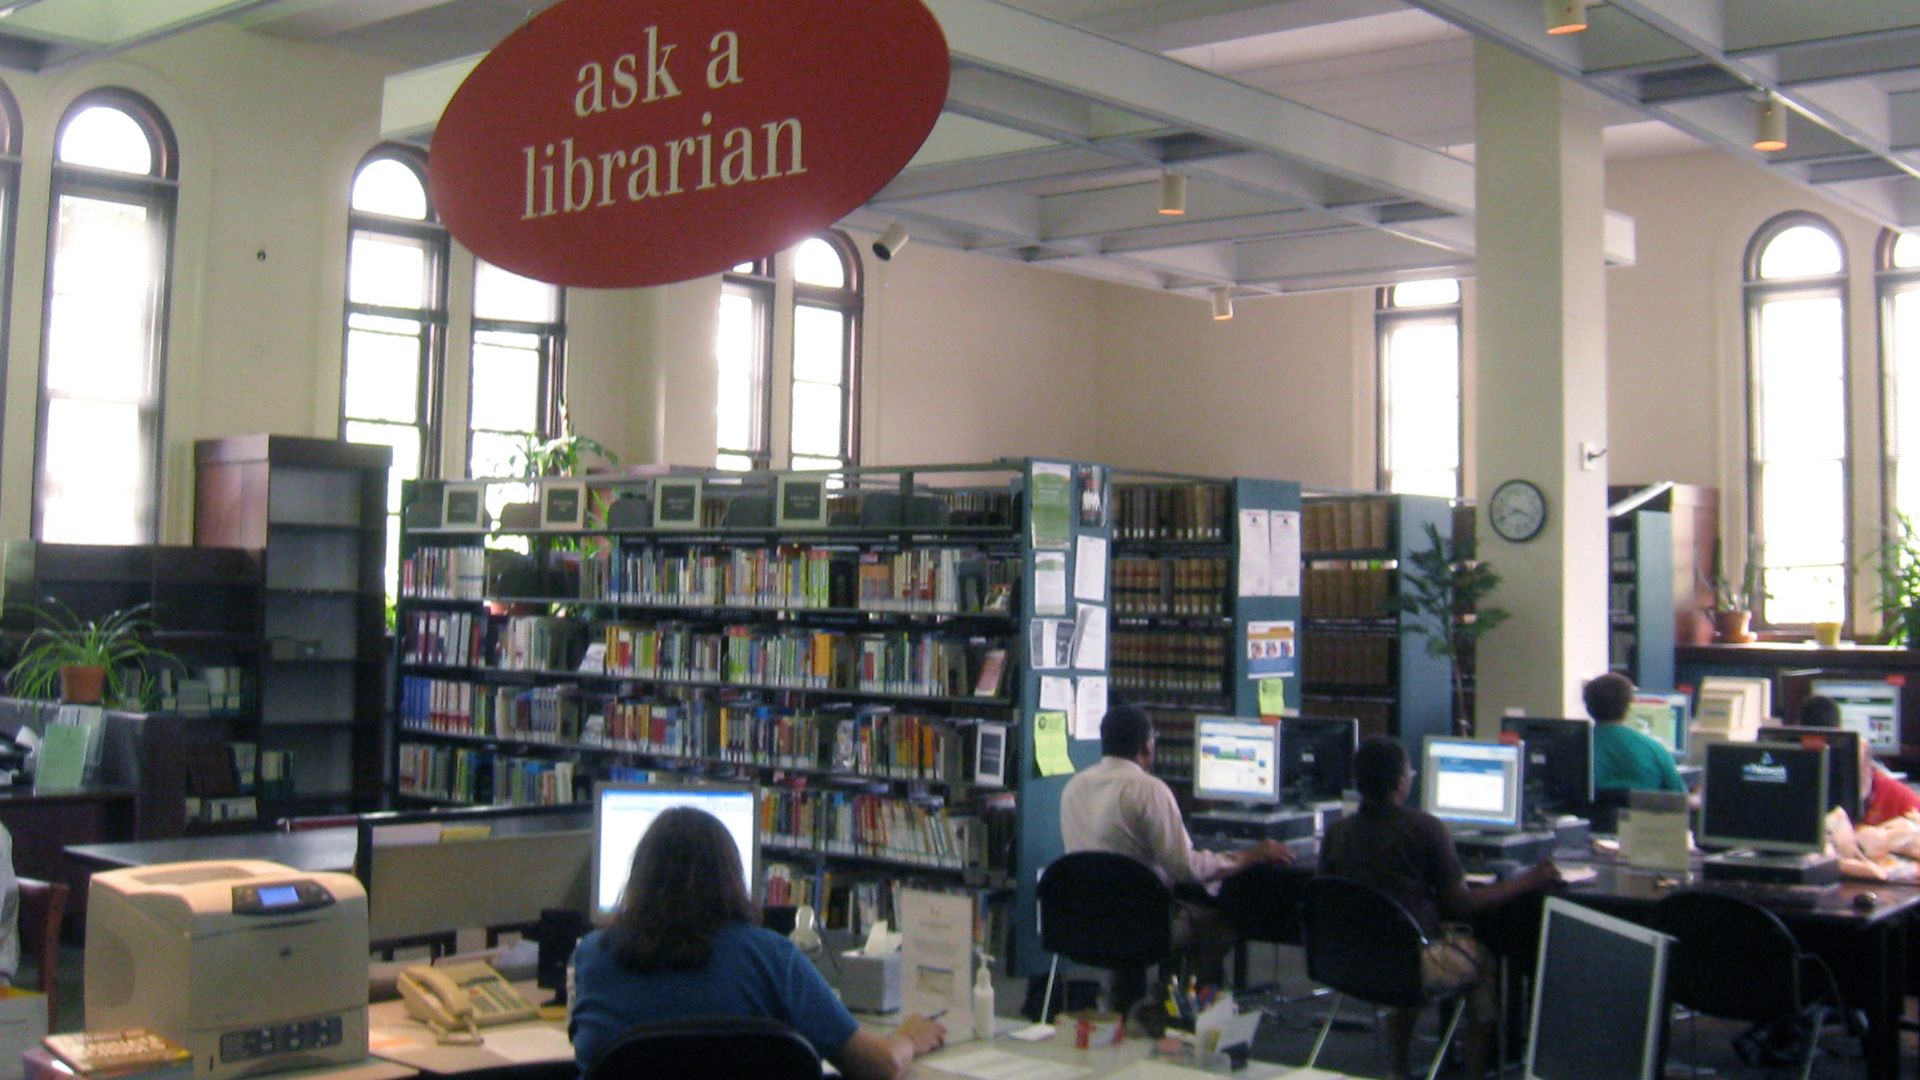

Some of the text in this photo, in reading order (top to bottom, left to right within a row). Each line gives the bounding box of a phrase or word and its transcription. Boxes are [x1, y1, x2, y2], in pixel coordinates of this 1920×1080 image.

[574, 26, 743, 117] ask a
[521, 111, 807, 220] librarian
